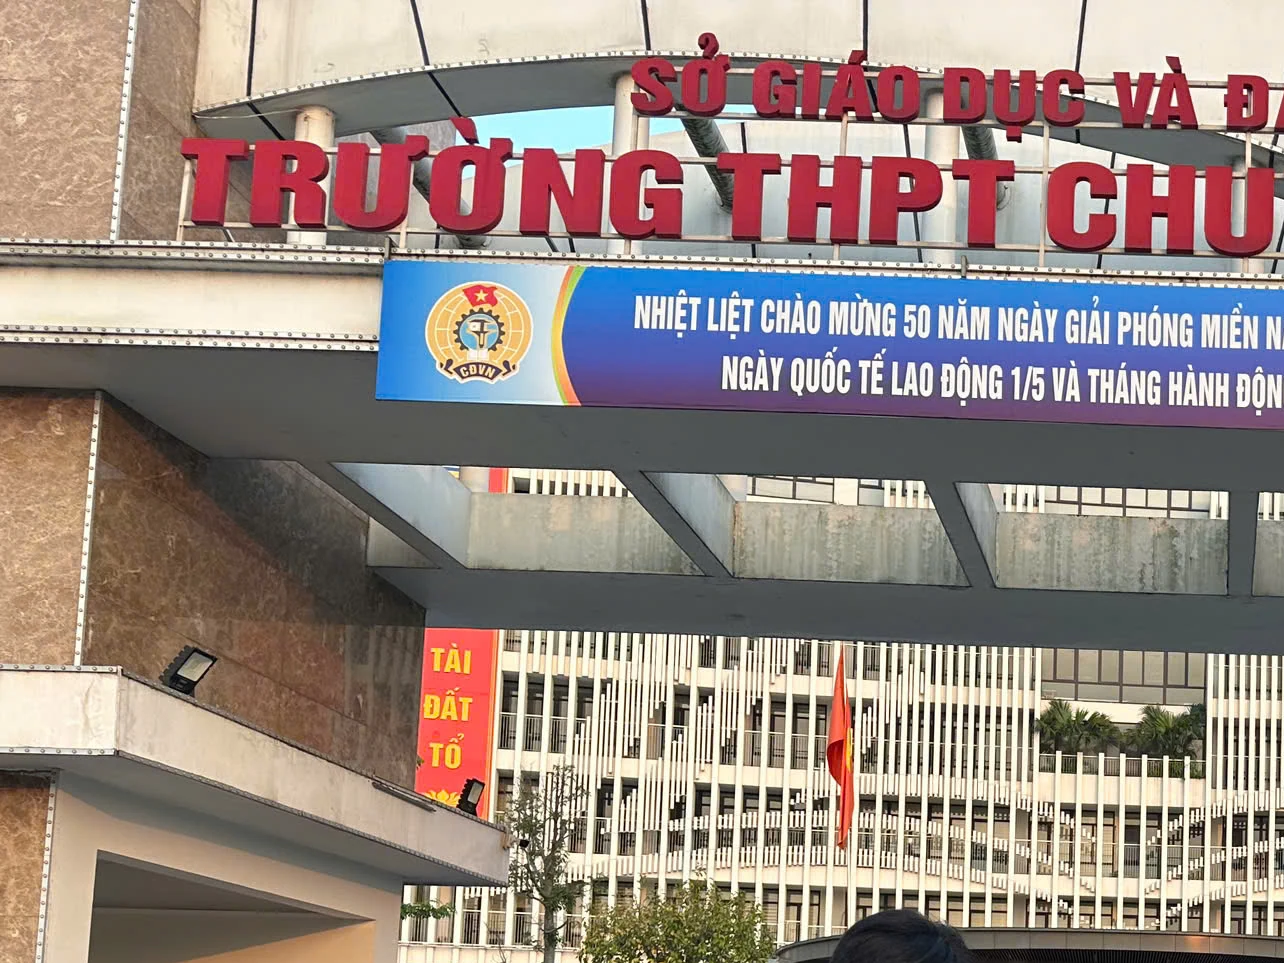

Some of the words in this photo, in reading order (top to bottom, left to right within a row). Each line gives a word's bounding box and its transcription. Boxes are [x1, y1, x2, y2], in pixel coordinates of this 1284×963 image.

[631, 33, 730, 117] SỞ
[752, 50, 921, 123] GIÁO
[943, 68, 1086, 142] DỤC
[1113, 57, 1199, 130] VÀ
[180, 116, 683, 240] TRƯỜNG
[717, 152, 1016, 249] THPT
[633, 289, 702, 338] NHIỆT
[707, 291, 755, 340] LIỆT
[760, 293, 821, 335] CHÀO
[828, 293, 897, 337] MỪNG
[903, 304, 931, 339] 50
[937, 298, 991, 341] NĂM
[997, 301, 1059, 344] NGÀY
[1065, 295, 1111, 346] GIẢI
[1117, 305, 1194, 349] PHÓNG
[1200, 303, 1259, 350] MIỀN
[460, 364, 496, 378] CĐVN
[721, 349, 785, 392] NGÀY
[790, 346, 852, 397] QUỐC
[858, 348, 887, 395] TẾ
[891, 360, 934, 398] LAO
[940, 356, 1004, 407] ĐỘNG
[1010, 366, 1045, 402] 1/5
[1051, 359, 1081, 403] VÀ
[1087, 361, 1162, 406] THÁNG
[1168, 363, 1230, 408] HÀNH
[430, 643, 472, 675] TÀI
[423, 687, 473, 722] ĐẤT
[429, 732, 465, 769] TỔ
